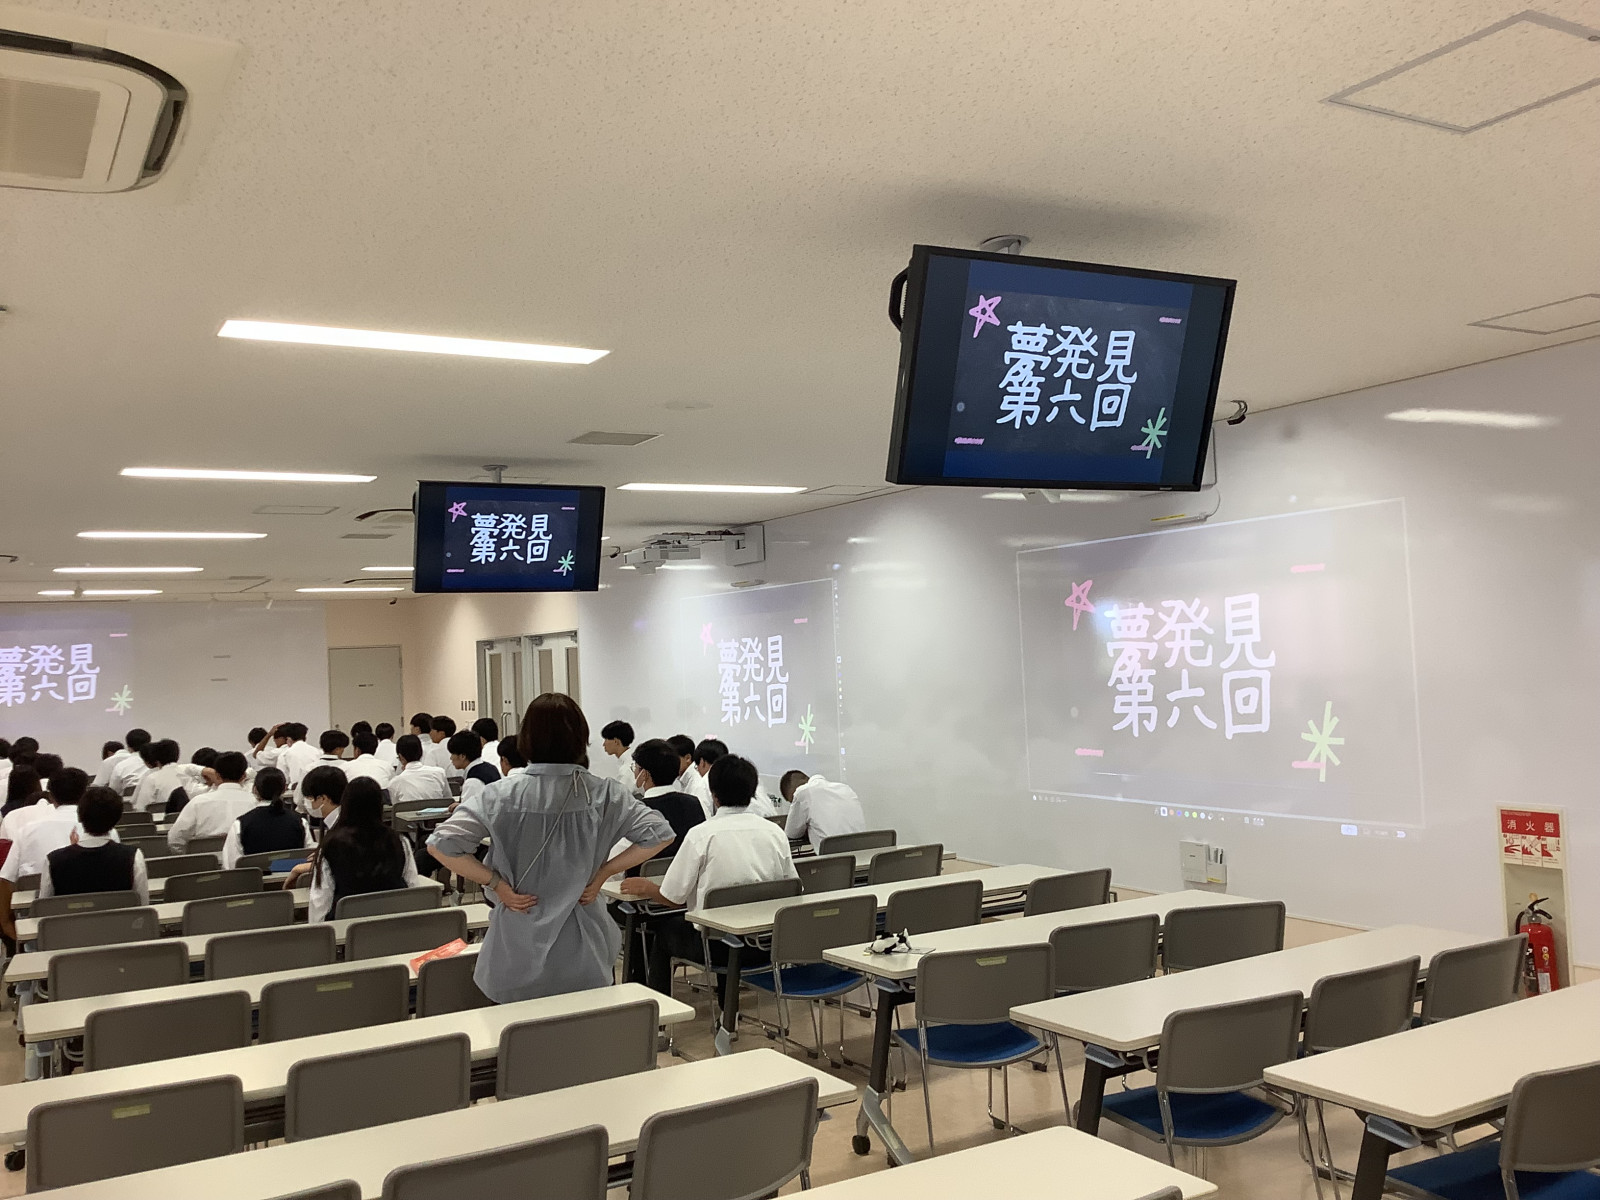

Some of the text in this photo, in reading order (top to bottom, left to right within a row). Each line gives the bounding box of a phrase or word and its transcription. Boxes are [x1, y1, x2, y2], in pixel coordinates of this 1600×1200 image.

[1000, 321, 1137, 385] 夢発見
[996, 376, 1131, 431] 第六回
[470, 513, 552, 541] 夢発見
[470, 538, 550, 564] 第六回
[1104, 593, 1276, 672] 夢発見
[717, 635, 789, 685] 夢発見
[719, 681, 788, 728] 第六回
[1111, 668, 1272, 739] 第六回
[1507, 819, 1554, 833] 消火器
